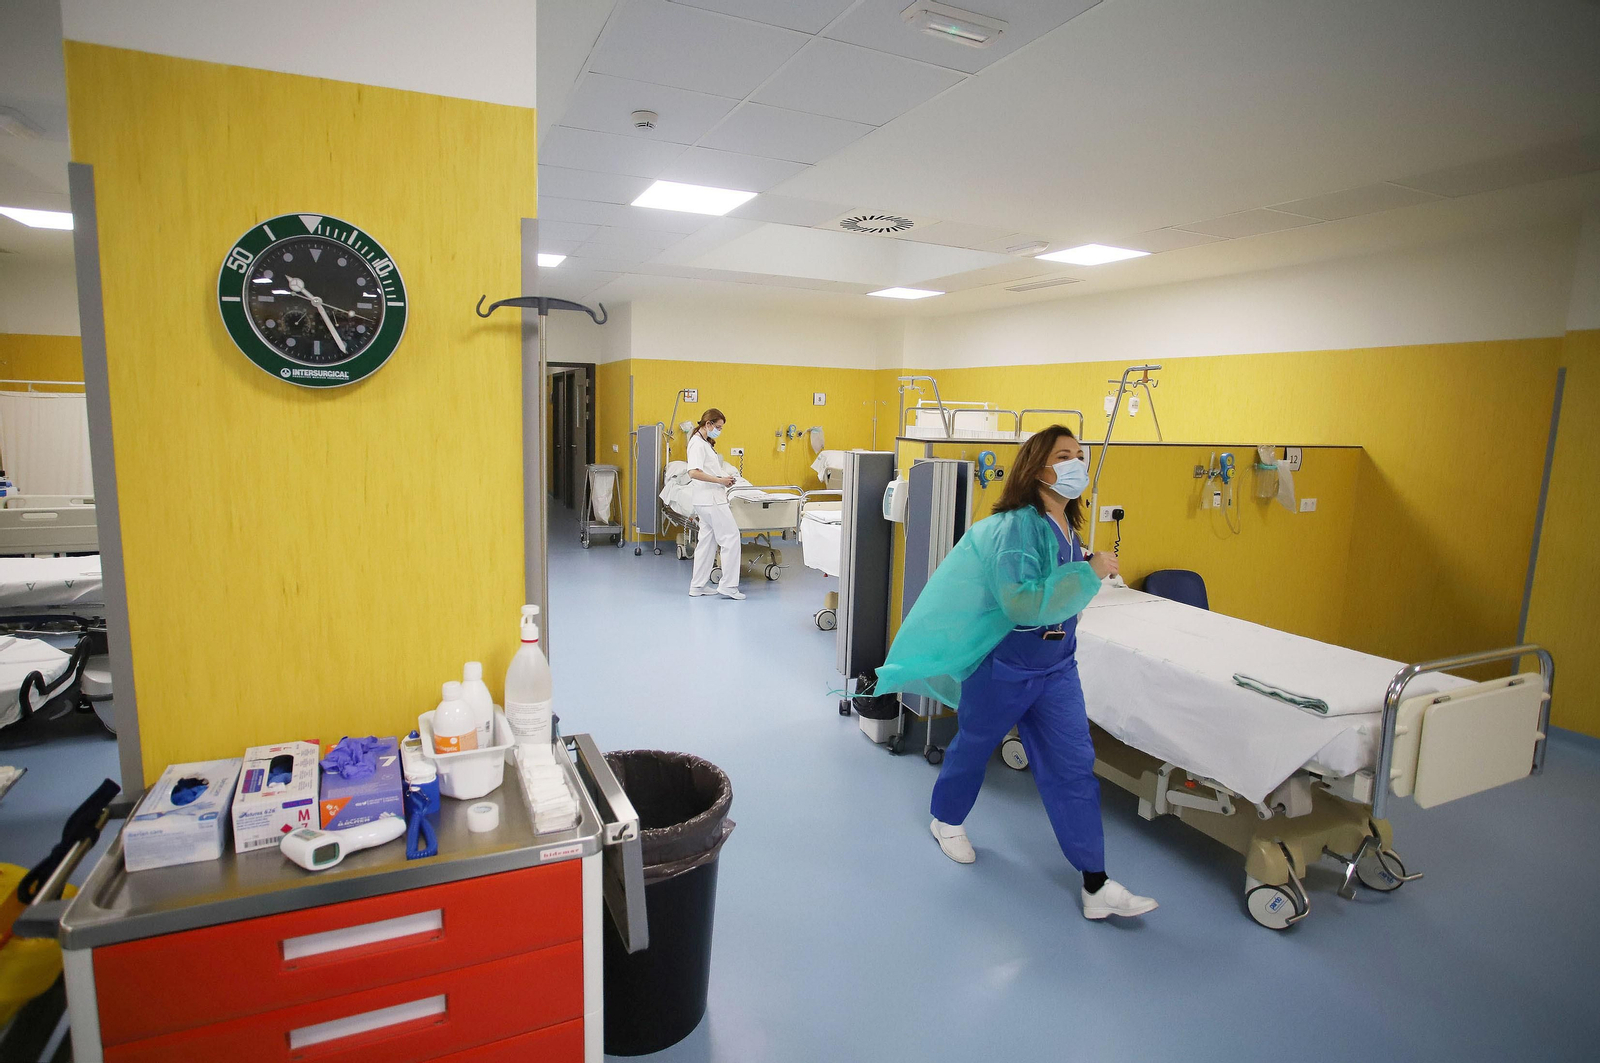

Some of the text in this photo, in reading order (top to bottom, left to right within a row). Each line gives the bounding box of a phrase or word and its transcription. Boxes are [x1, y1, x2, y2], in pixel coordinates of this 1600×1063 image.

[226, 246, 254, 274] 50
[373, 257, 394, 276] 10
[292, 368, 350, 378] INTERSURGICAL
[1290, 455, 1298, 464] 12
[379, 755, 397, 767] 7
[298, 808, 311, 822] M
